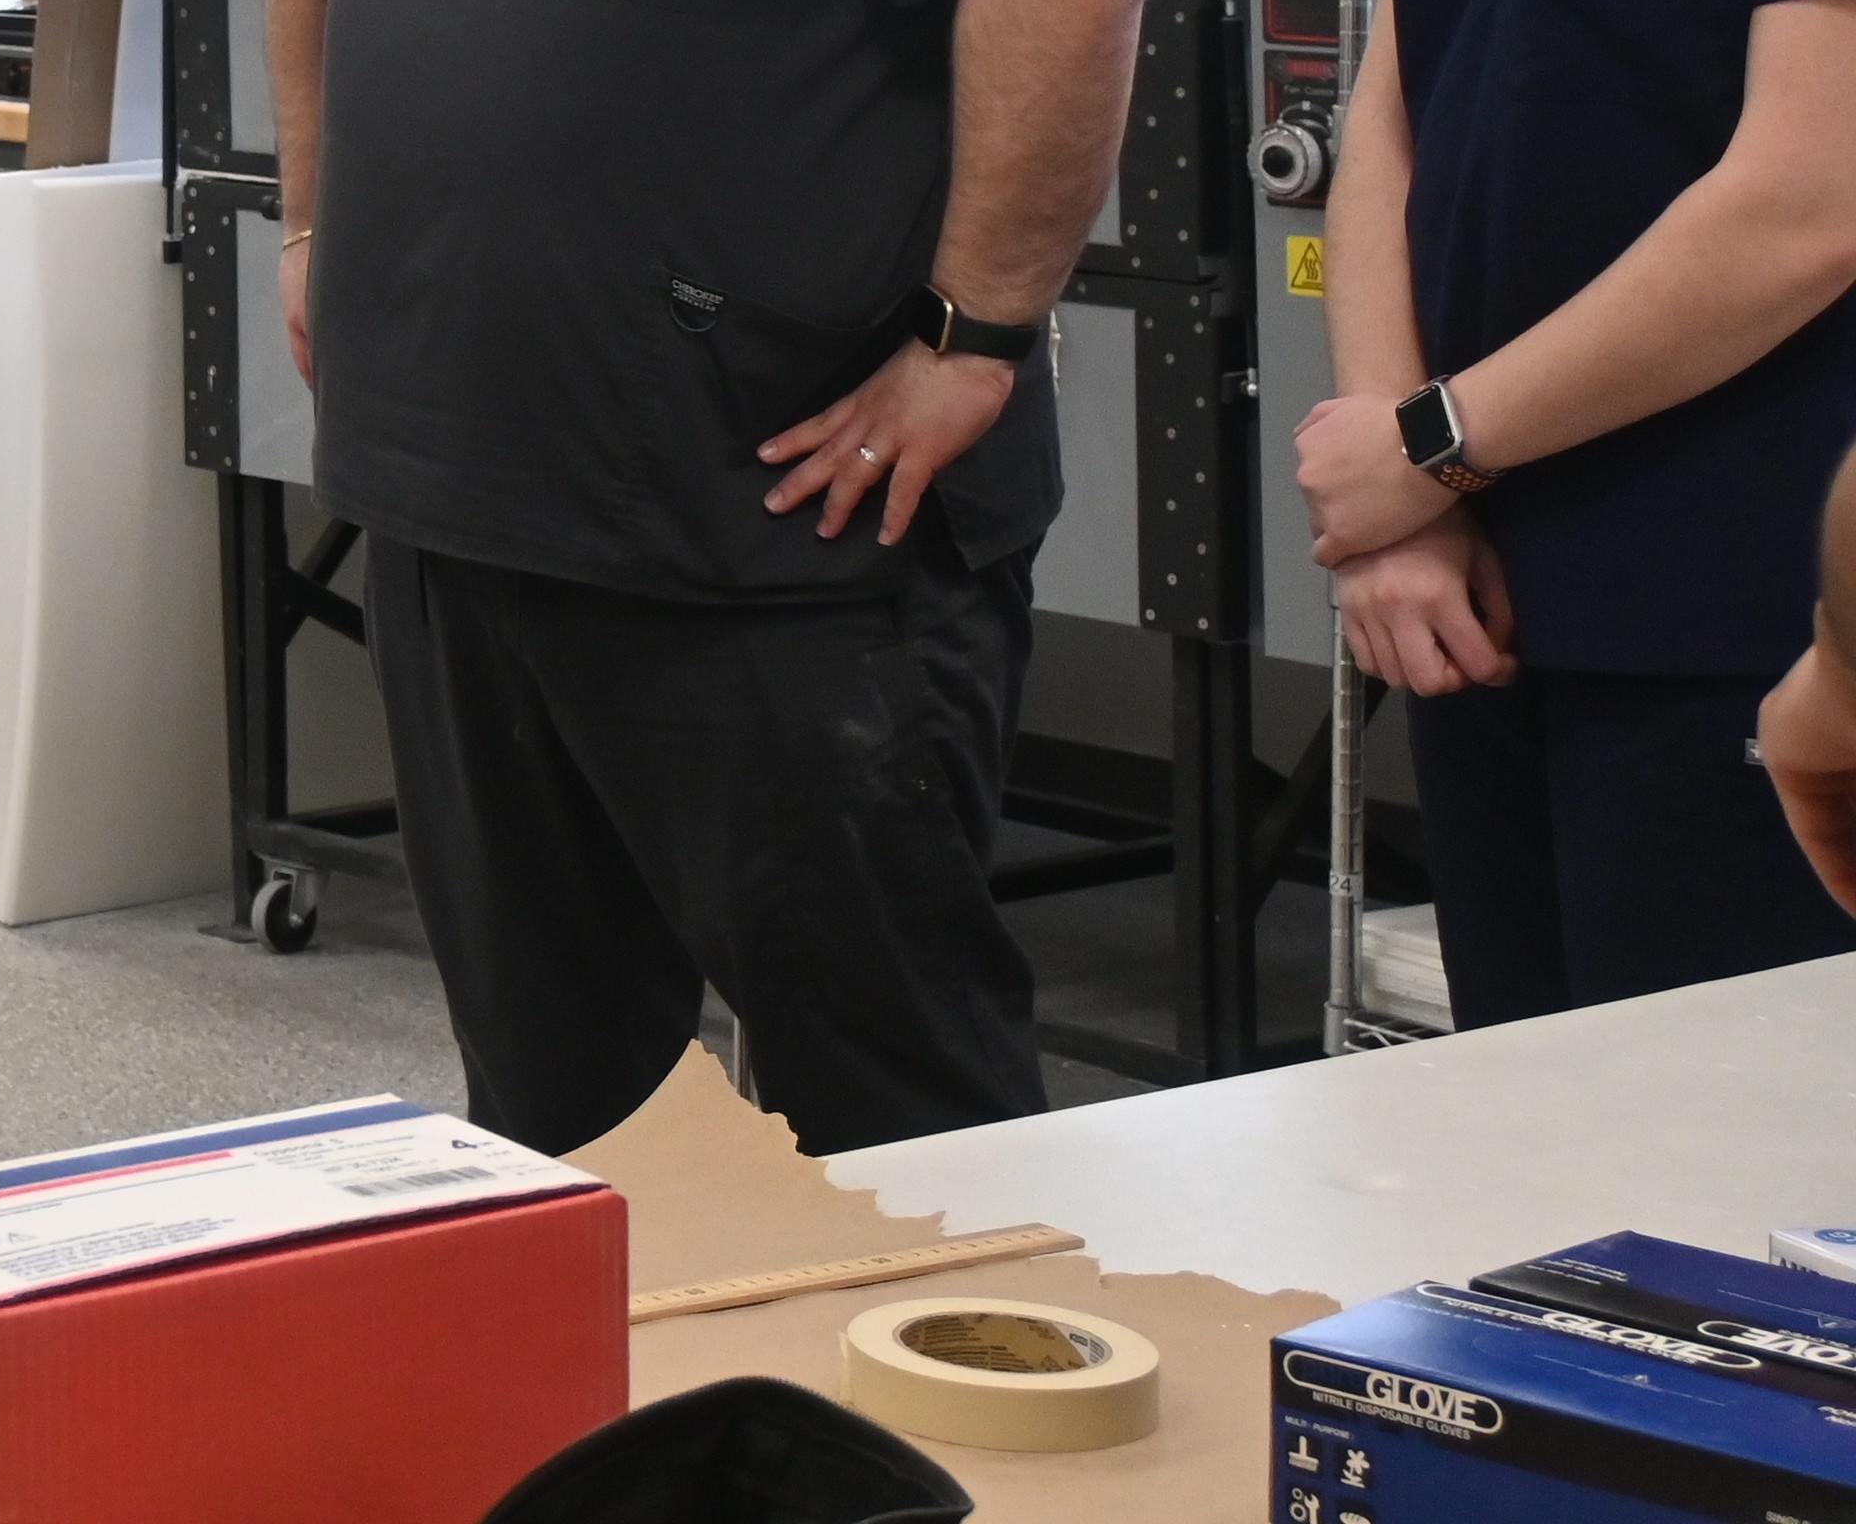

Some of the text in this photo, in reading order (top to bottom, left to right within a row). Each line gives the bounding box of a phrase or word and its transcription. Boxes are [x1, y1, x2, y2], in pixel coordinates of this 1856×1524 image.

[1542, 1312, 1715, 1364] GLOVE
[1729, 1326, 1855, 1365] OVE
[1313, 1390, 1471, 1441] NITRILE DISPOSABLE GLOVES
[1366, 1372, 1479, 1428] GLOVE
